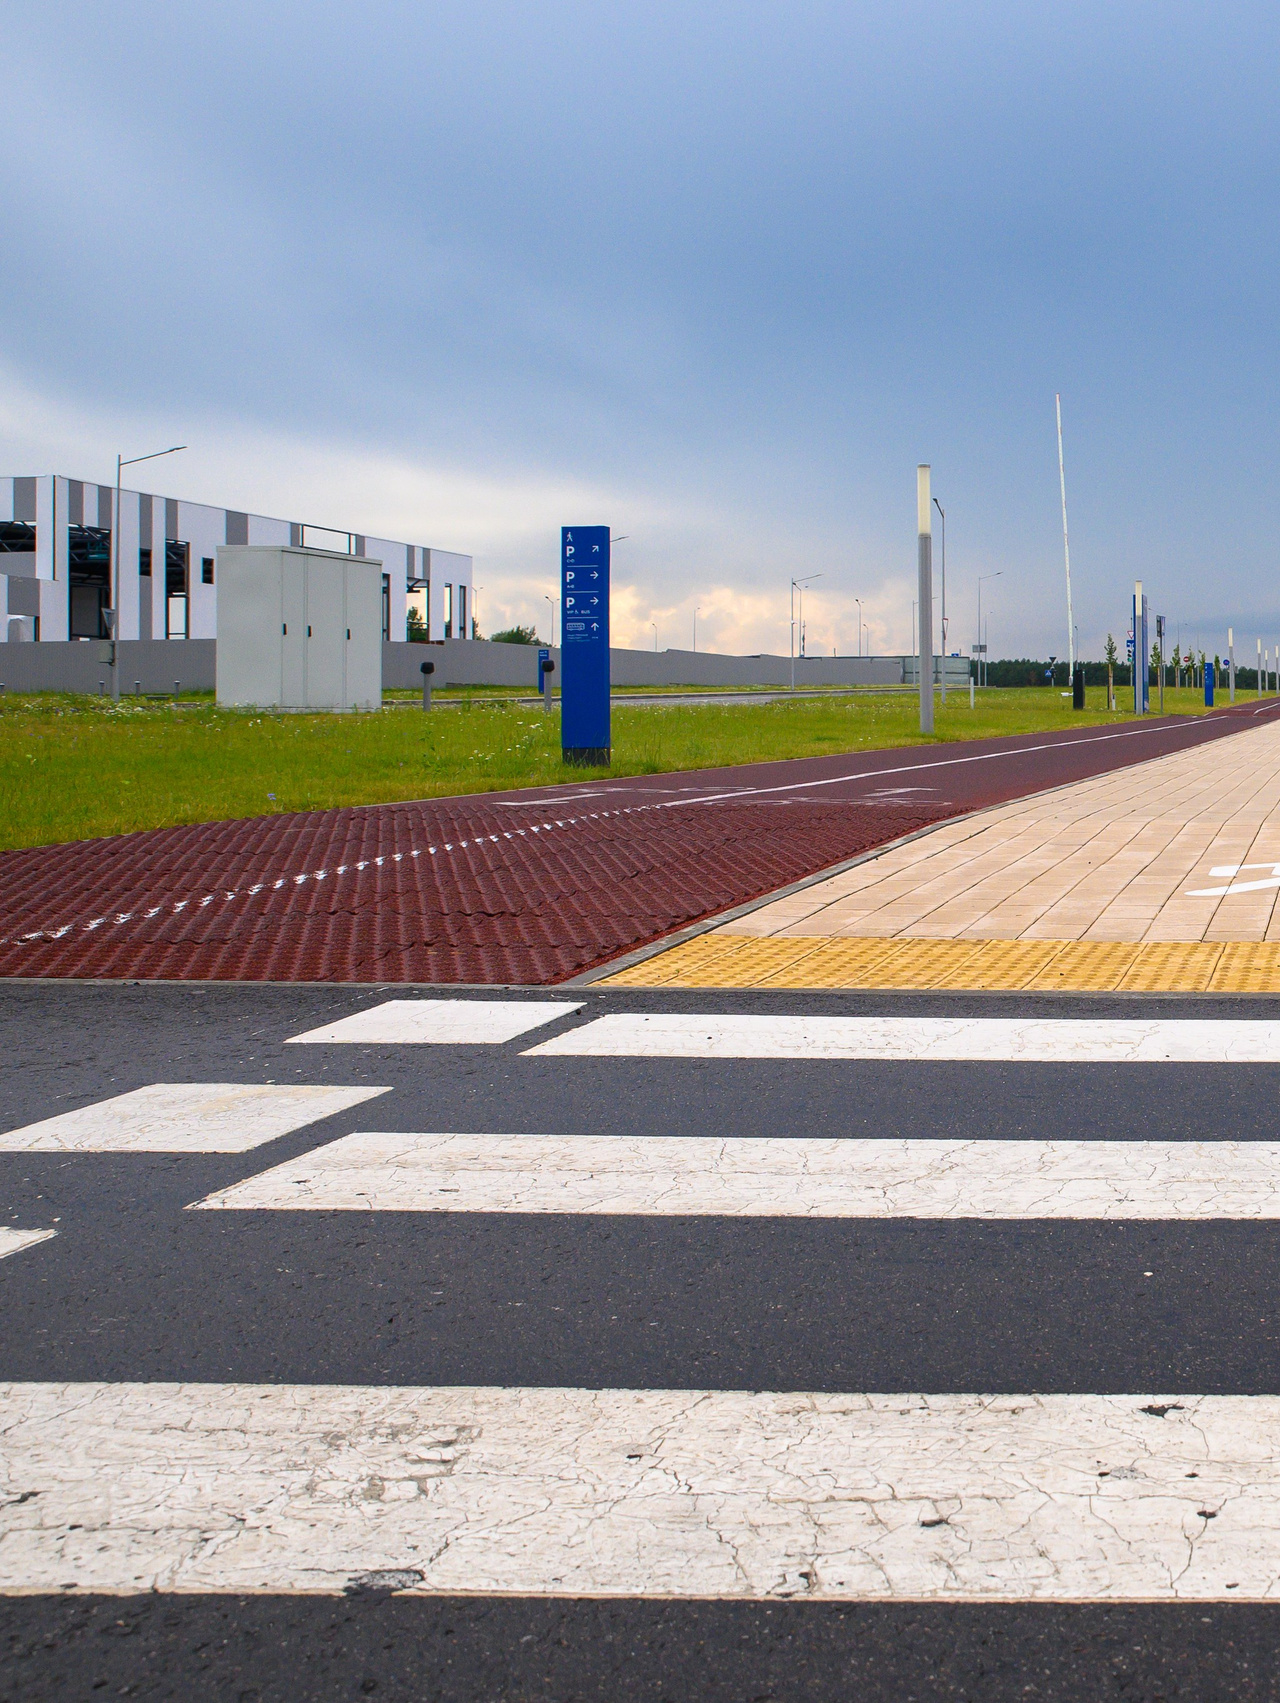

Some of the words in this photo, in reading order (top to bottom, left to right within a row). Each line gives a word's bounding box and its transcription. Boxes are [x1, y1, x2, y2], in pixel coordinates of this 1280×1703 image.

[566, 546, 575, 557] P
[566, 571, 575, 582] P
[566, 597, 575, 608] P
